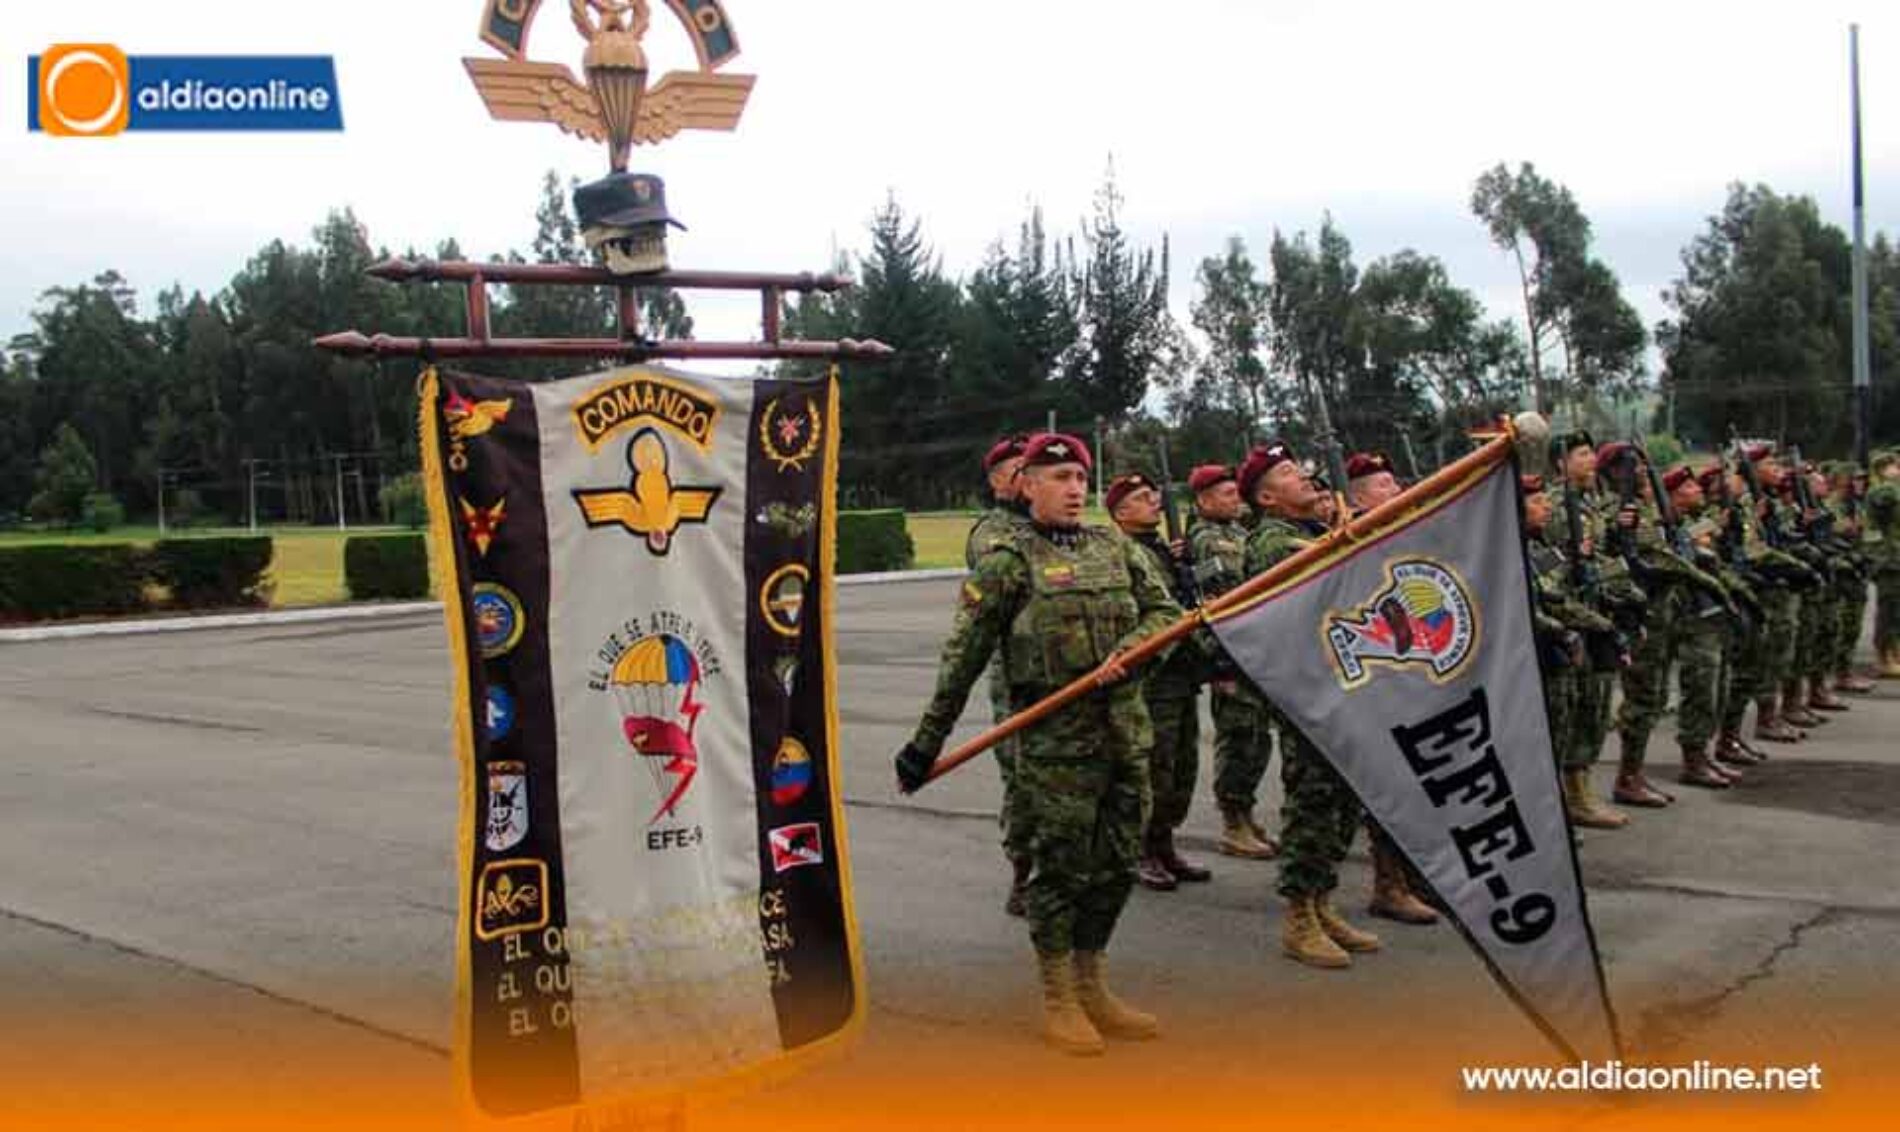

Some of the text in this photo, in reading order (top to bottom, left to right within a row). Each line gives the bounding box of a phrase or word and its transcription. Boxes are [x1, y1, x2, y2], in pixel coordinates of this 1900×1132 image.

[582, 383, 708, 439] COMANDO
[598, 633, 626, 664] QUE
[624, 617, 644, 641] SE
[1389, 687, 1557, 945] EFE-9
[503, 933, 531, 962] EL
[498, 972, 523, 1001] EL
[509, 1009, 538, 1036] EL
